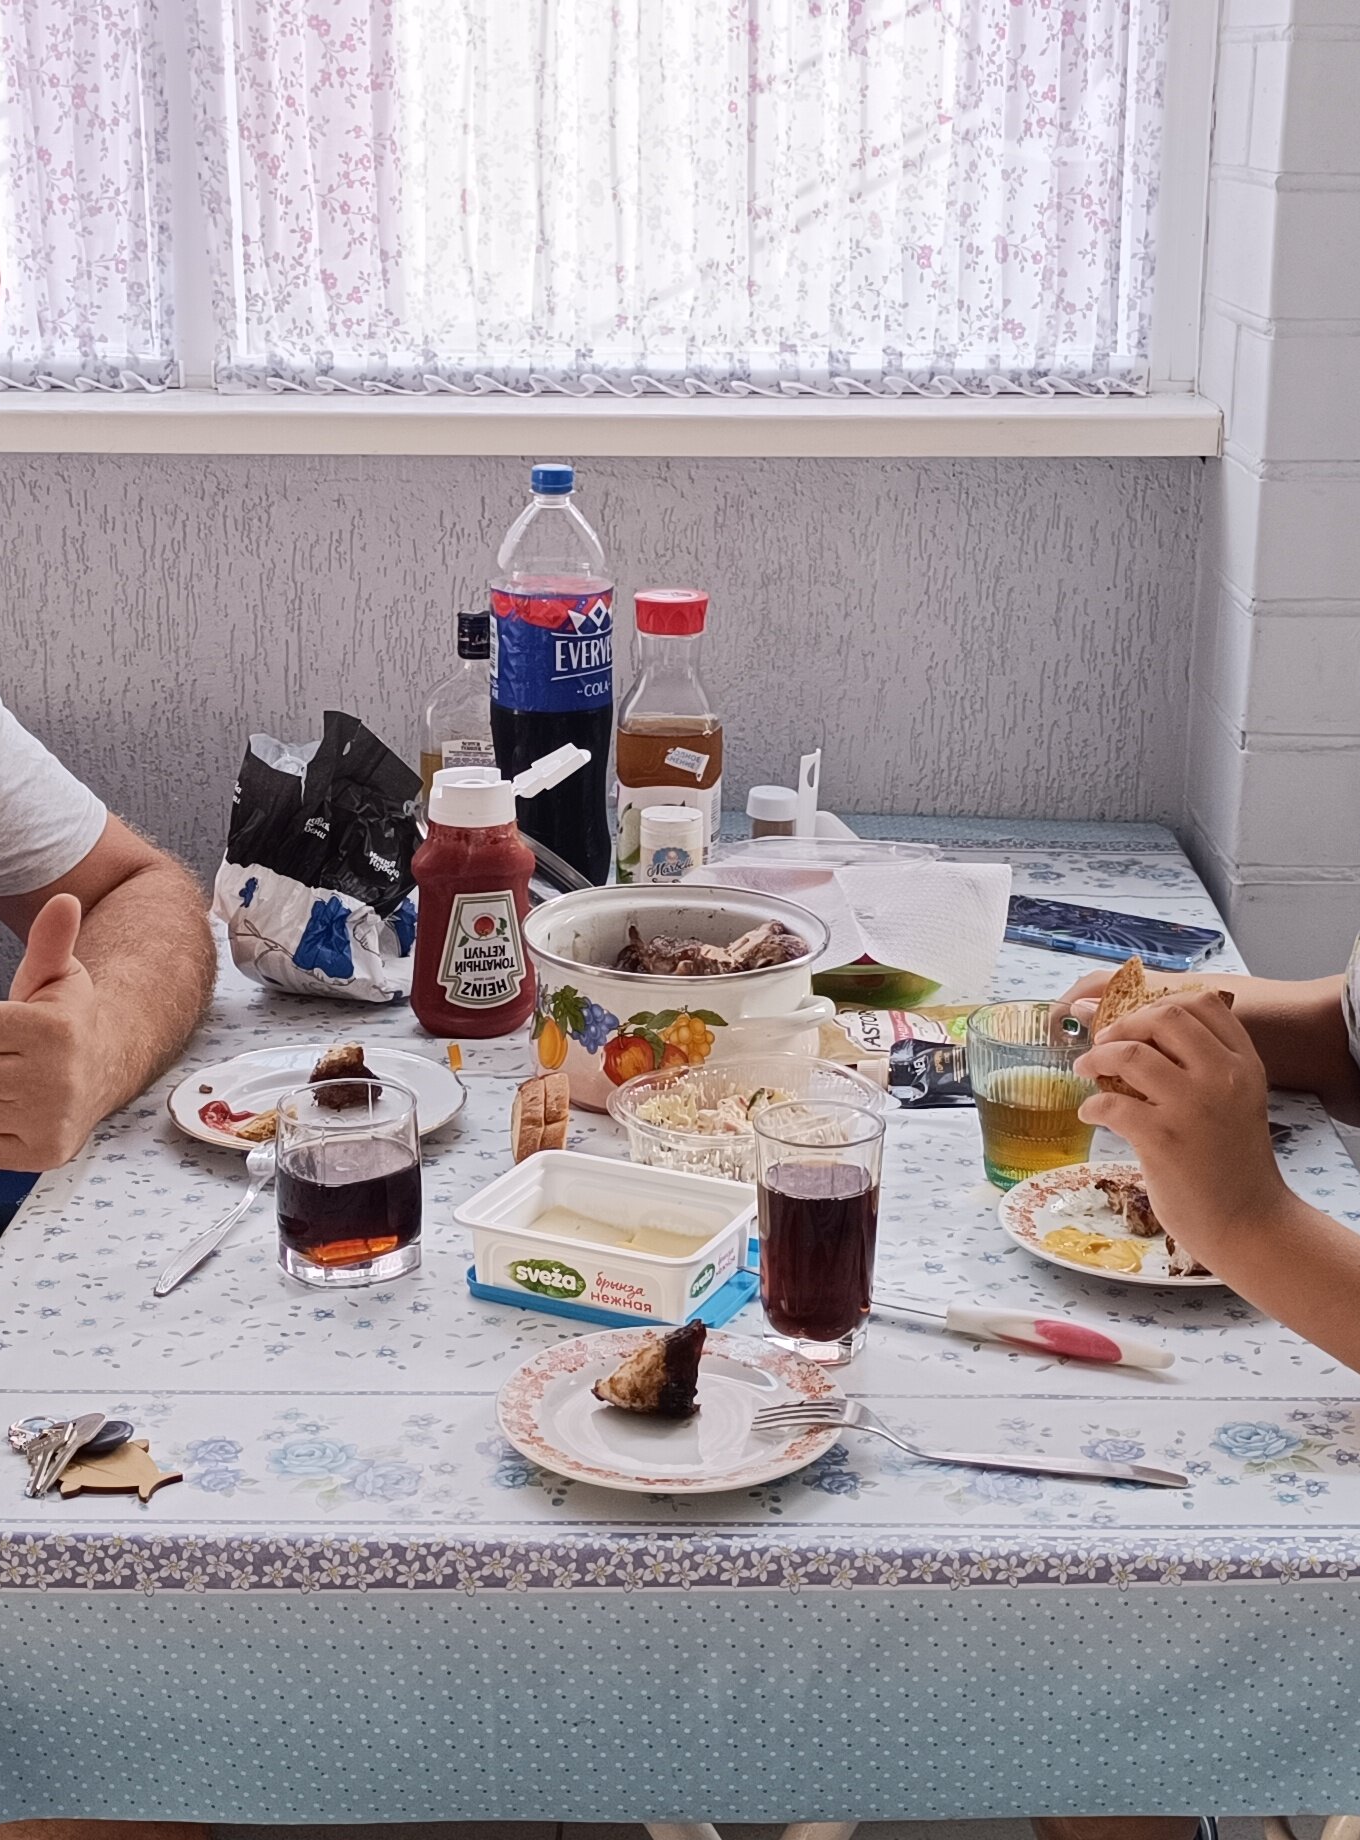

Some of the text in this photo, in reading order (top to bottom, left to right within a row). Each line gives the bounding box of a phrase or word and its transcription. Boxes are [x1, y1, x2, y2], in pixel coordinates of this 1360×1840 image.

[584, 681, 609, 697] COLA
[463, 945, 506, 960] КЕТЧУП
[454, 956, 516, 976] ТОМАТНЫЙ
[460, 978, 508, 998] HEINZ
[515, 1264, 577, 1292] sveža
[595, 1270, 646, 1298] брынза
[591, 1290, 652, 1313] нежная
